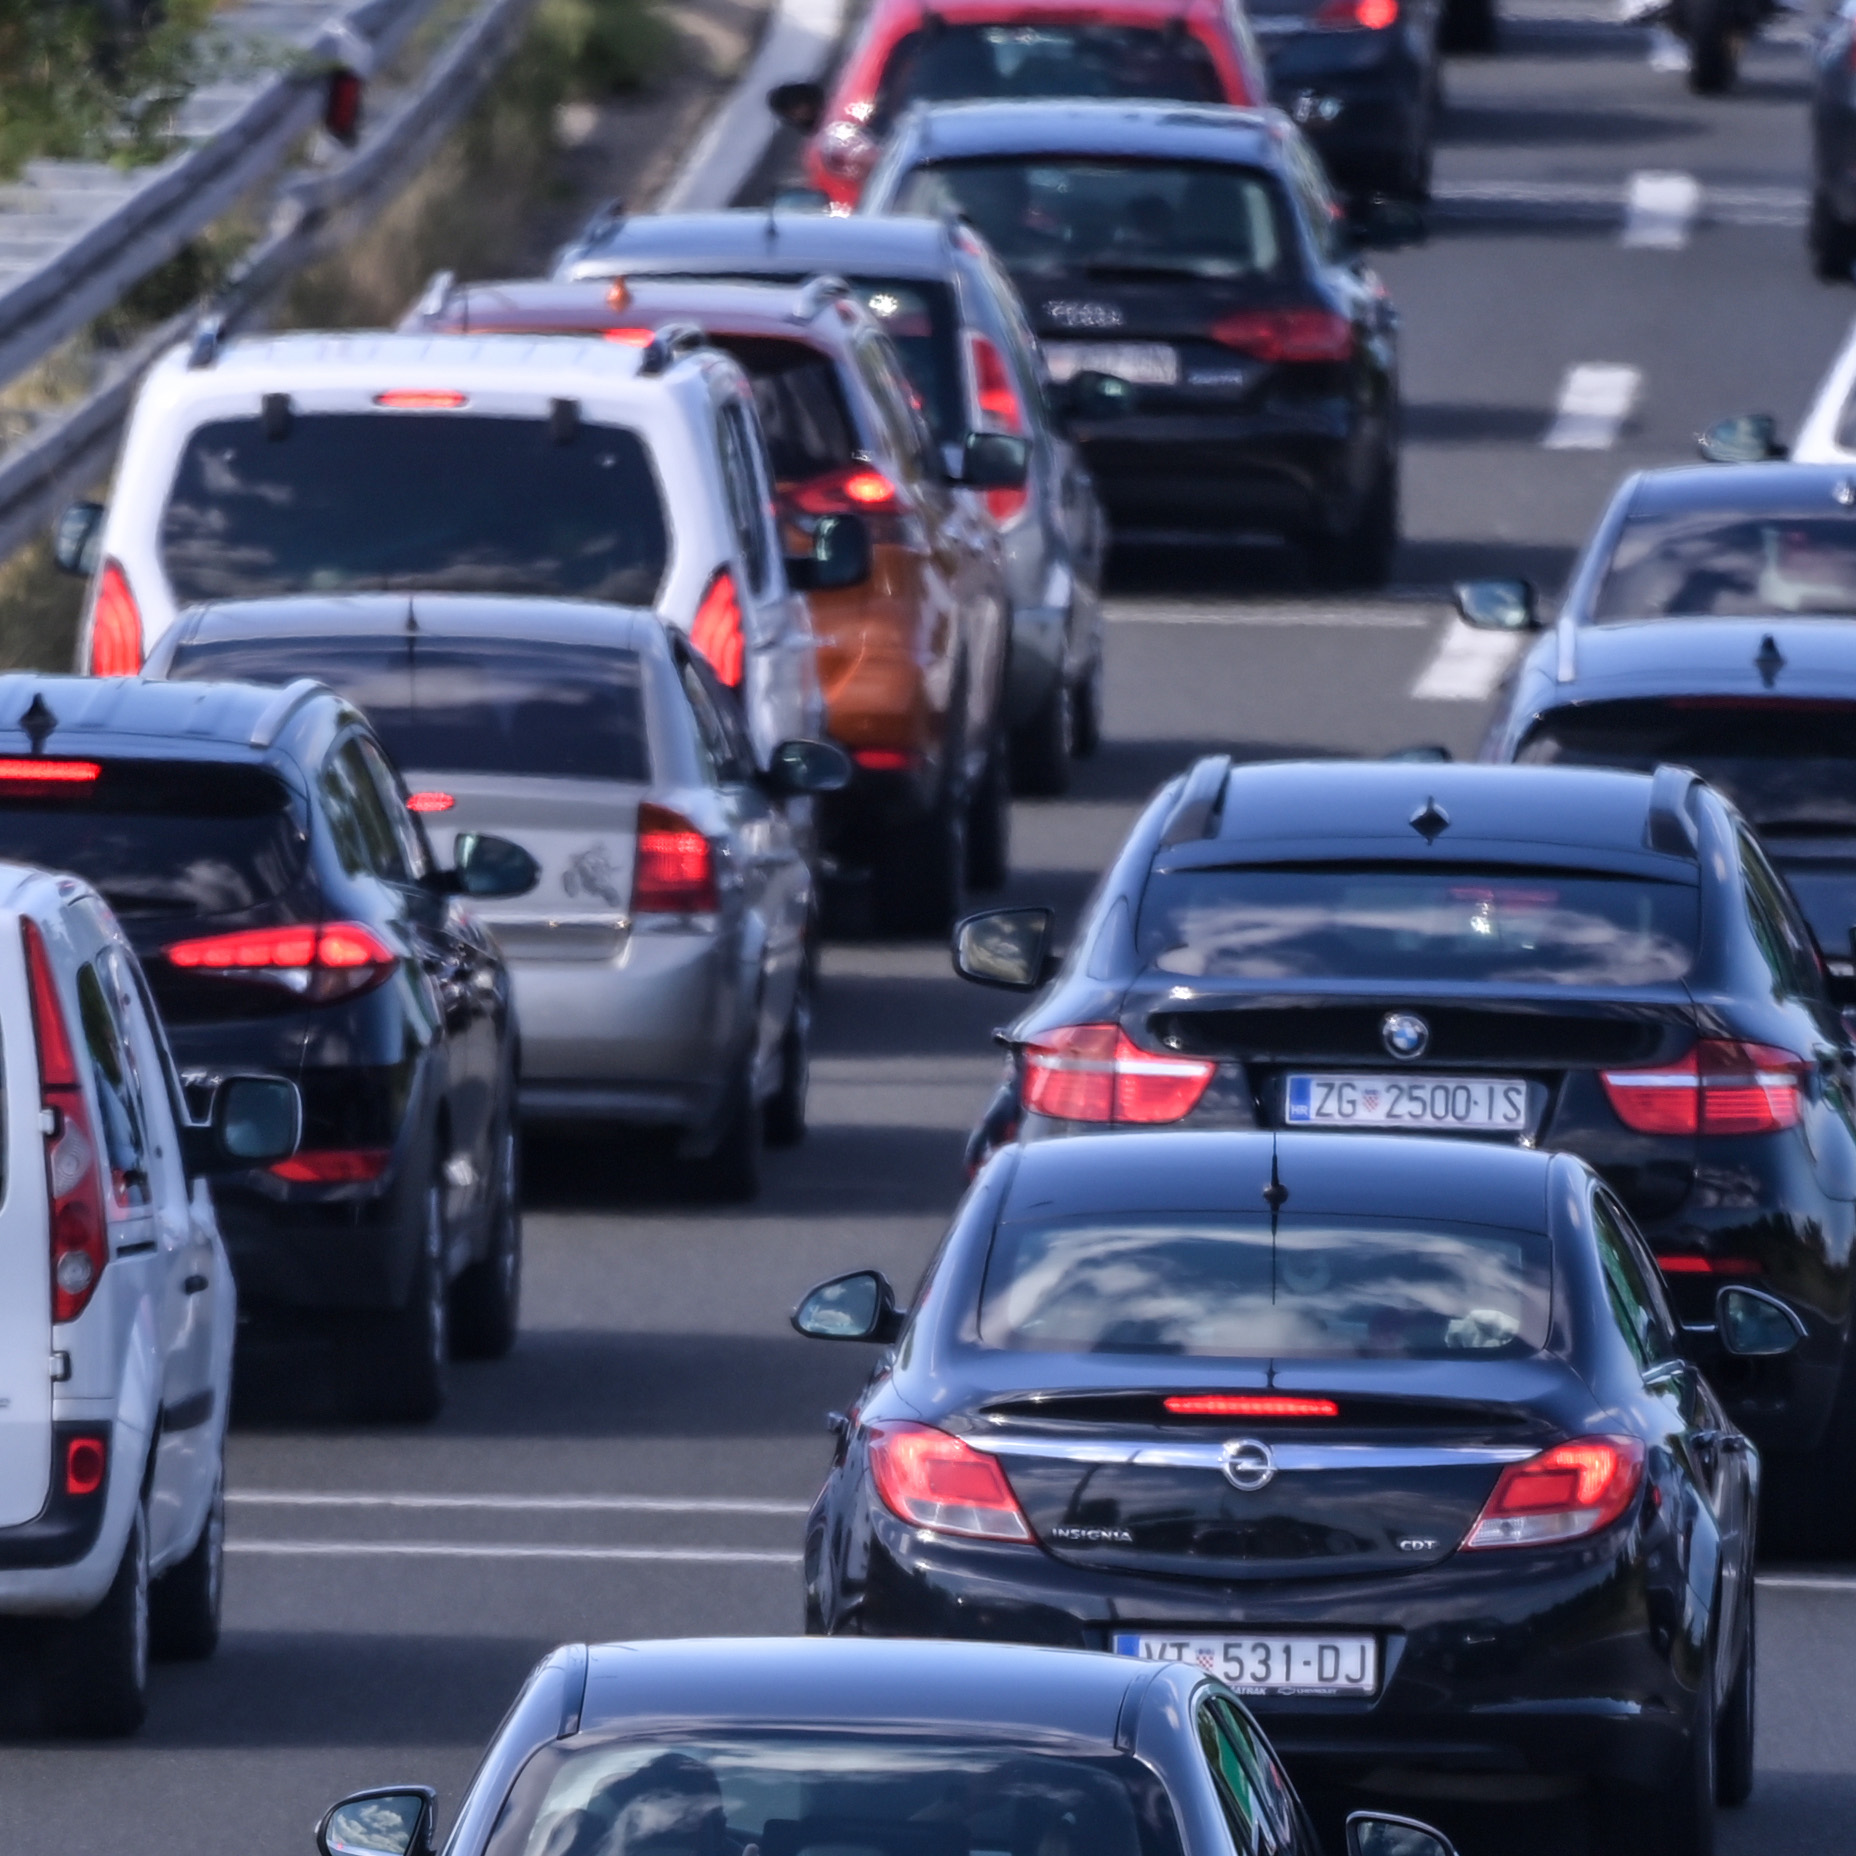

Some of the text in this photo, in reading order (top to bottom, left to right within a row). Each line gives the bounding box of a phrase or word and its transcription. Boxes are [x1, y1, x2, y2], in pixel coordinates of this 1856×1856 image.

[1291, 1105, 1309, 1116] HR
[1314, 1082, 1357, 1118] ZG
[1051, 1527, 1134, 1543] INSIGNIA
[1221, 1641, 1367, 1684] 531-DJ
